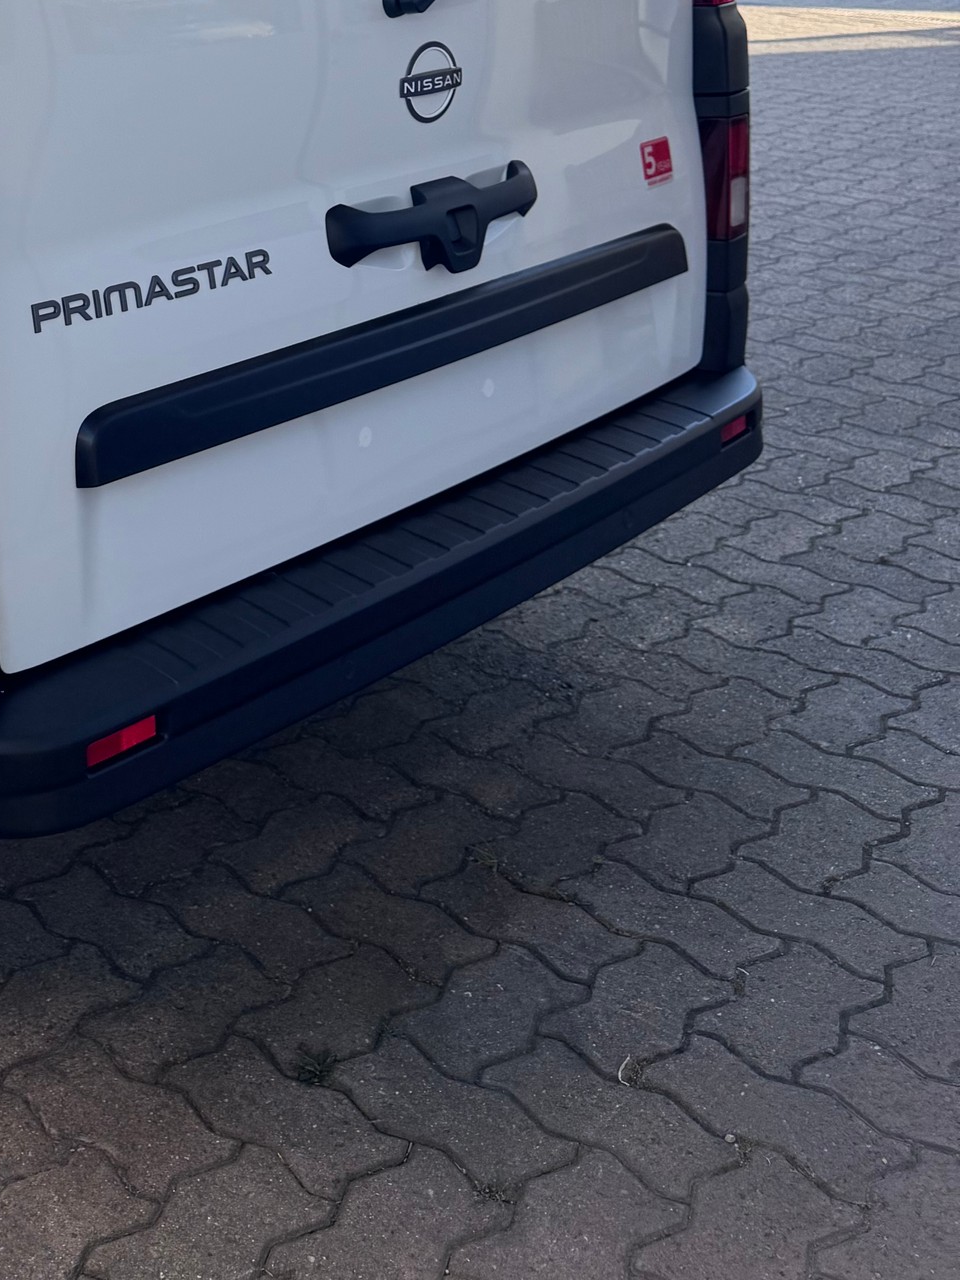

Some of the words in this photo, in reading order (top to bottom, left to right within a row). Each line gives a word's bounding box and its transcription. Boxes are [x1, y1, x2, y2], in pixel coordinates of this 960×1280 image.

[403, 71, 461, 94] NISSAN
[643, 145, 656, 176] 5
[30, 248, 273, 334] PRIMASTAR
